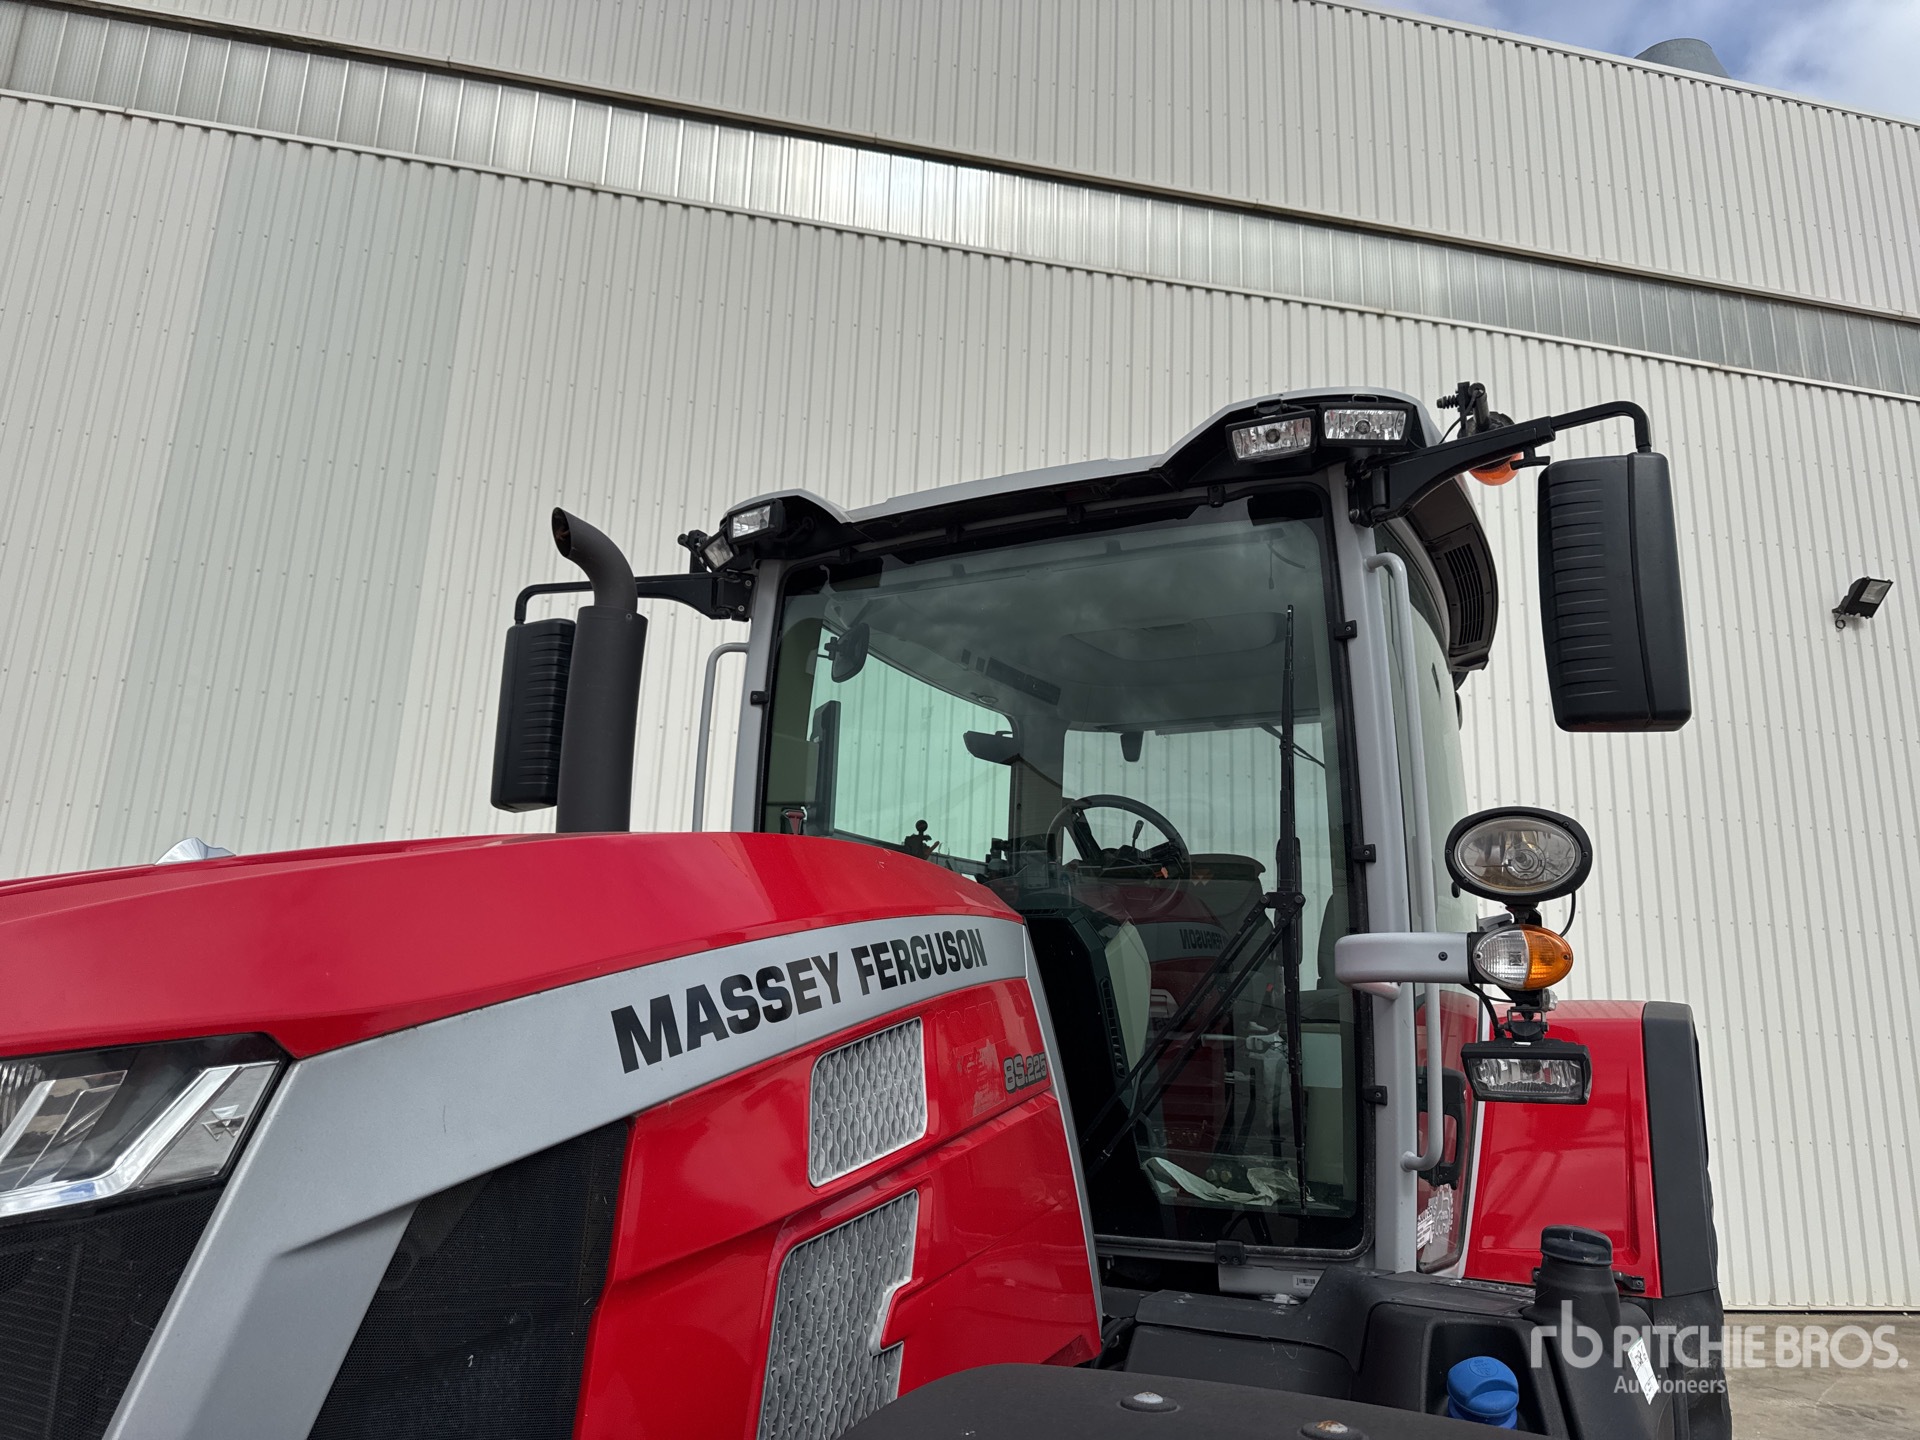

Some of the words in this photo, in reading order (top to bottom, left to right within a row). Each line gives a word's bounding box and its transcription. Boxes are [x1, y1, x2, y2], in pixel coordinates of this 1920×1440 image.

[610, 951, 842, 1074] MASSEY
[851, 928, 988, 996] FERGUSON
[1003, 1052, 1048, 1094] 8S.225
